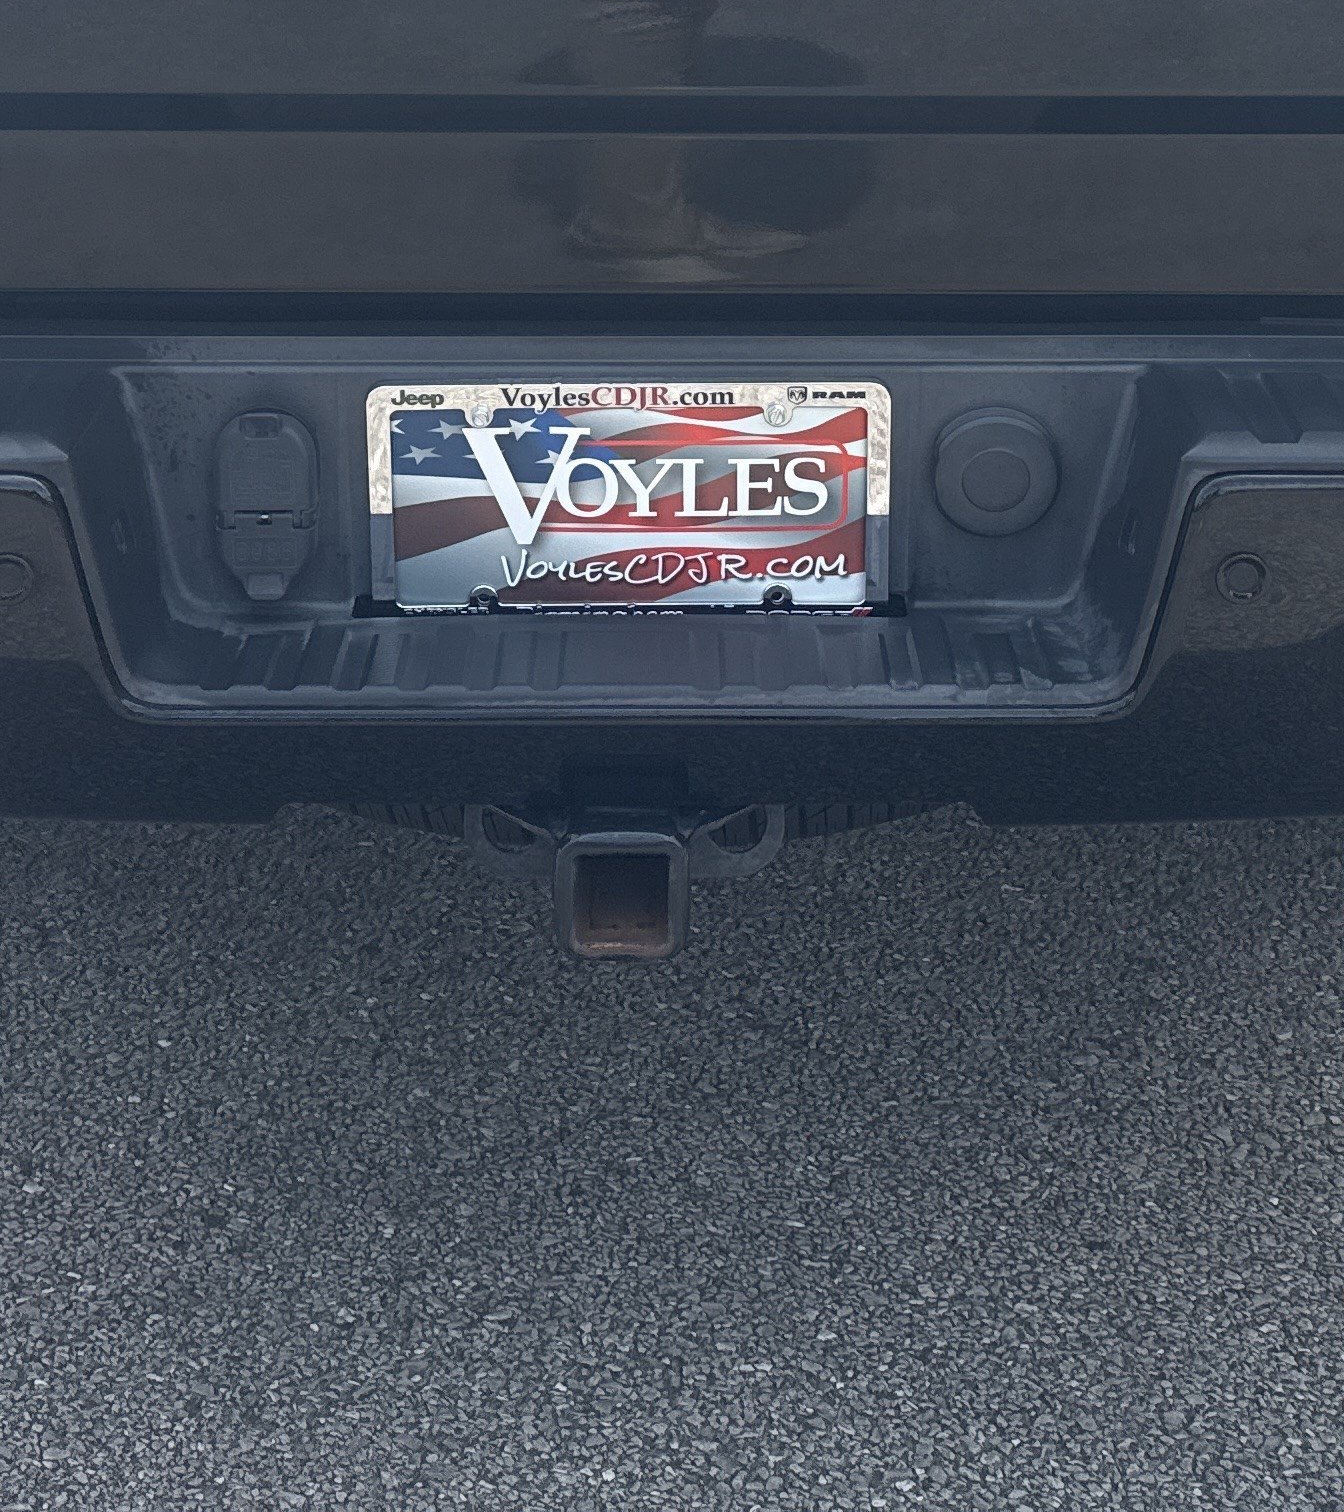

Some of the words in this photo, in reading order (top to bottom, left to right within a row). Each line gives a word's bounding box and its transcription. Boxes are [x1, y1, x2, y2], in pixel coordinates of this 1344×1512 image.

[391, 389, 445, 408] Jeep
[500, 386, 735, 413] VoylesCDJR.com
[812, 390, 867, 400] RAM
[462, 426, 829, 546] VOYLES
